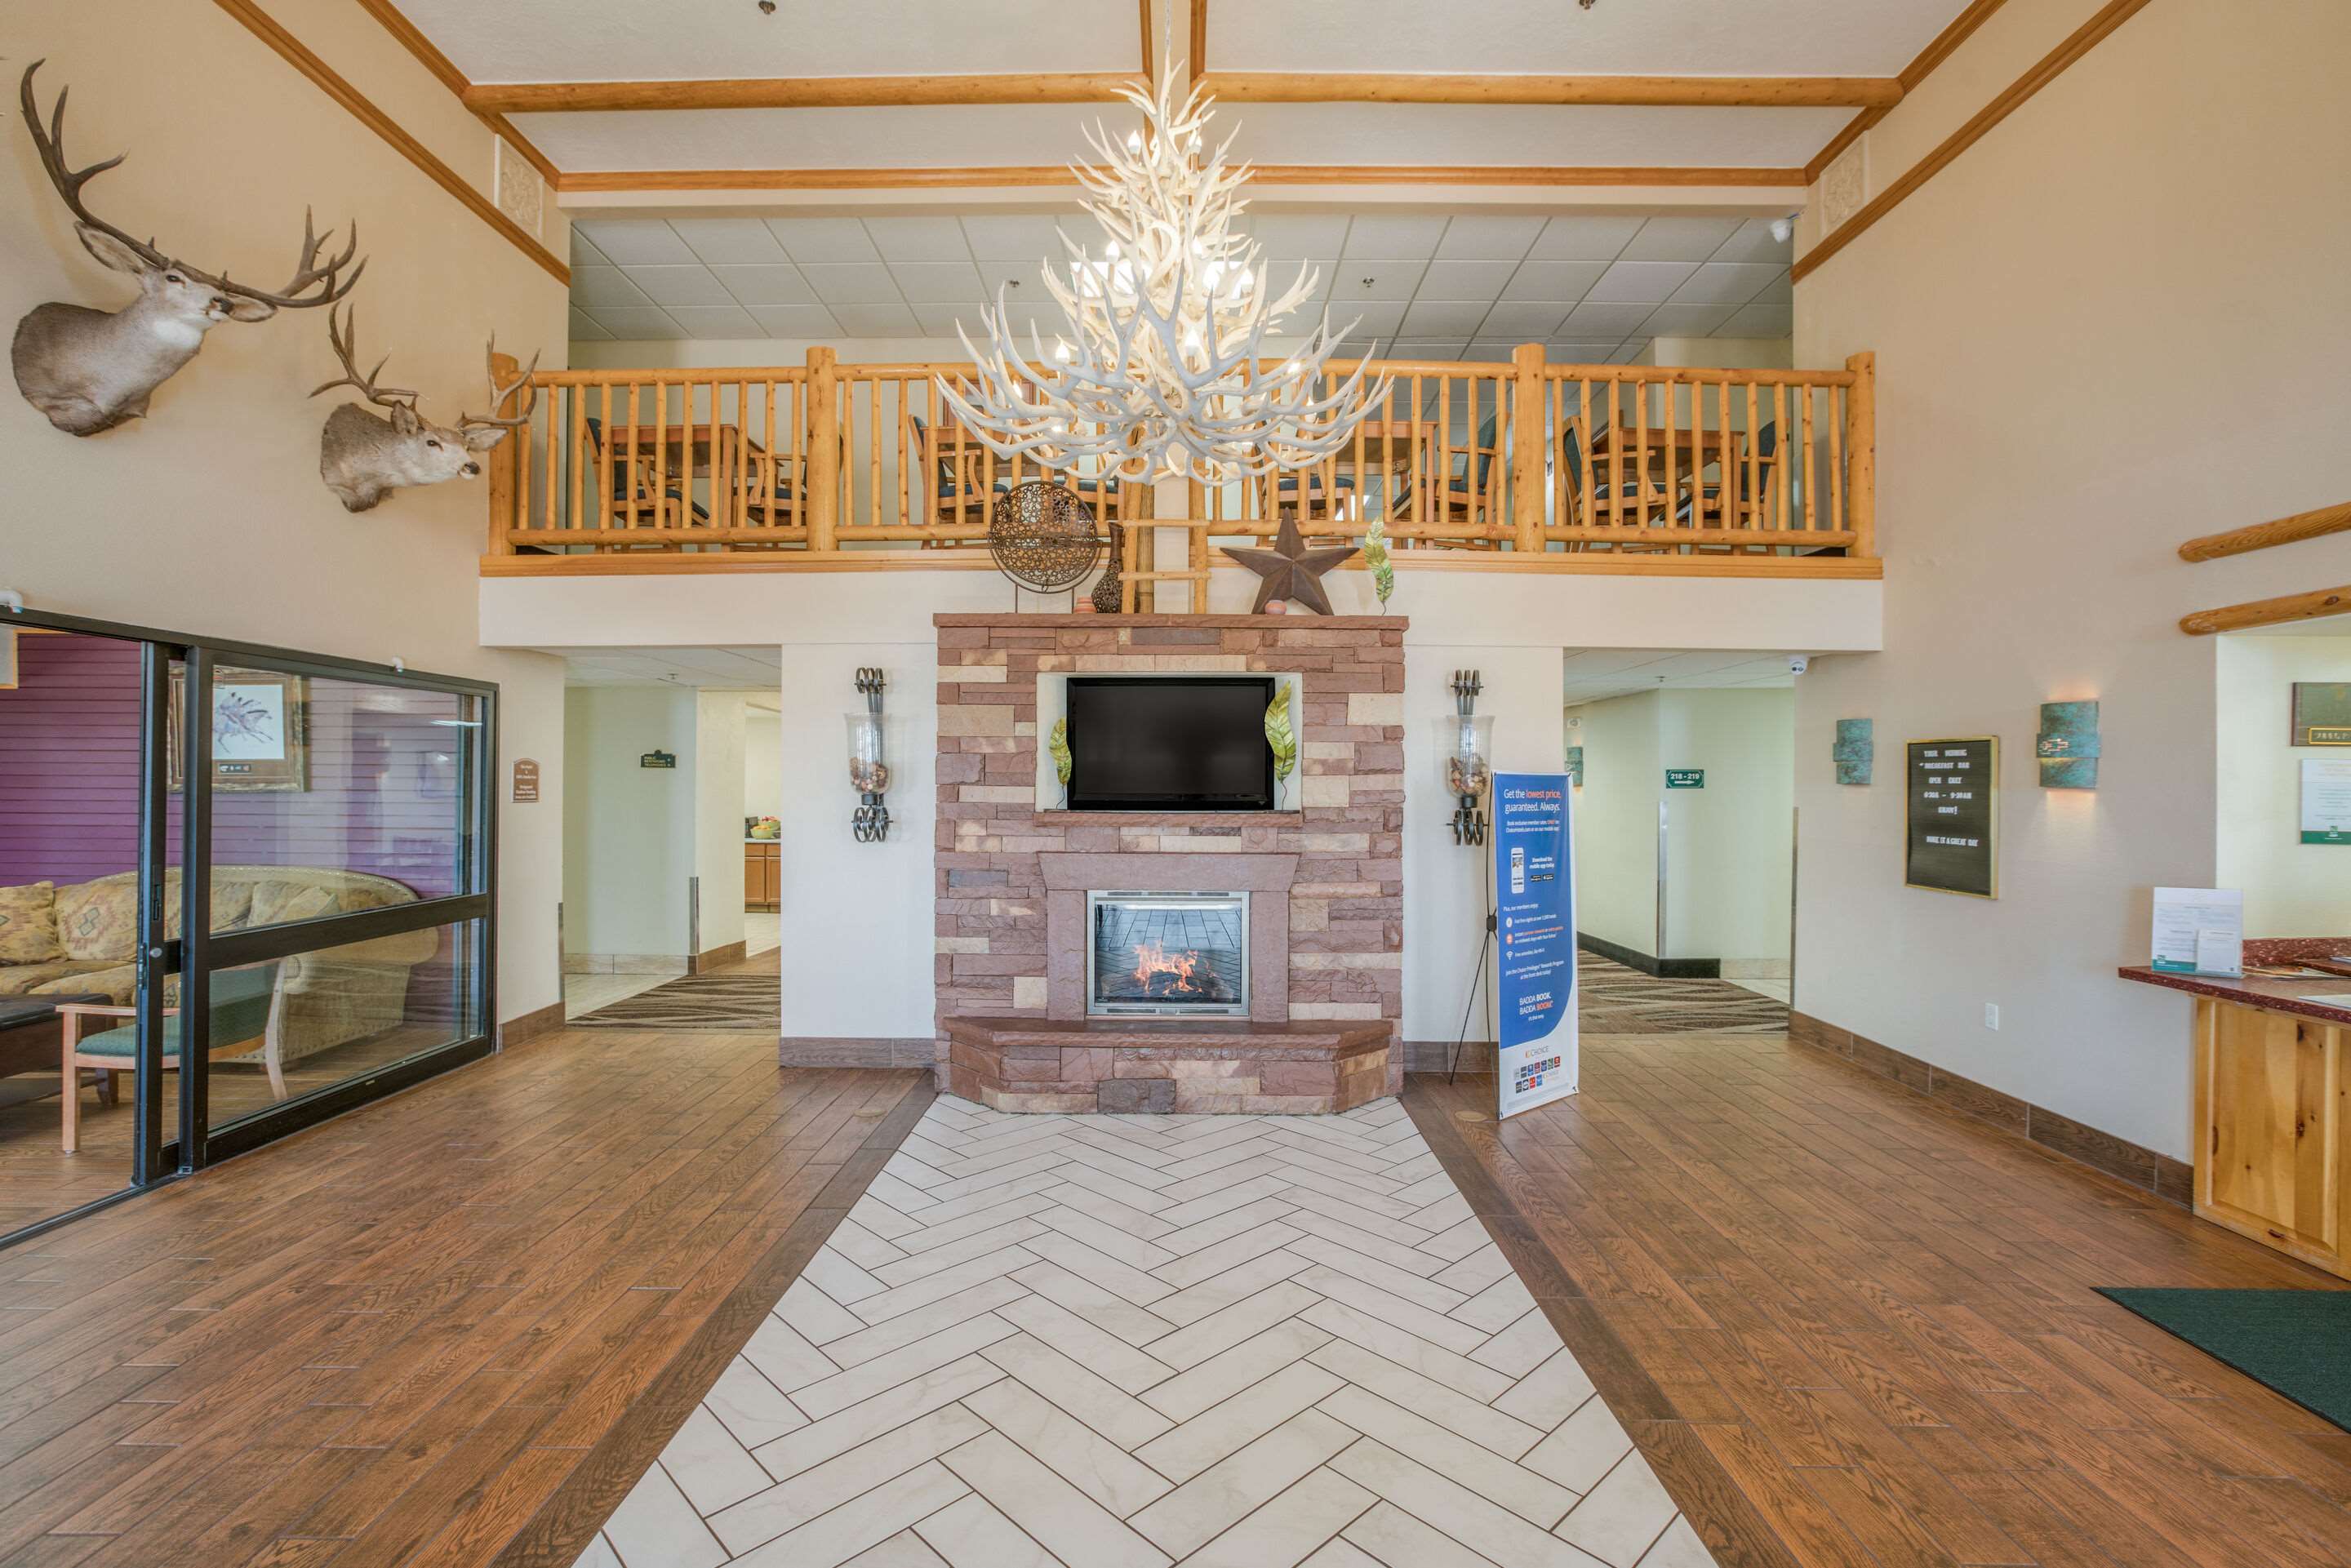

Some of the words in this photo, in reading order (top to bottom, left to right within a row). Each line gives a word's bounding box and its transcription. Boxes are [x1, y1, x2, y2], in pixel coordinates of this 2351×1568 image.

[1504, 788, 1515, 799] Get
[1515, 788, 1526, 799] the
[1526, 789, 1545, 799] lowest
[1504, 802, 1539, 815] guaranteed.
[1540, 802, 1561, 814] Always.
[1519, 994, 1535, 1006] BADDA
[1519, 1005, 1535, 1015] BADDA
[1531, 1046, 1549, 1056] CHOICE
